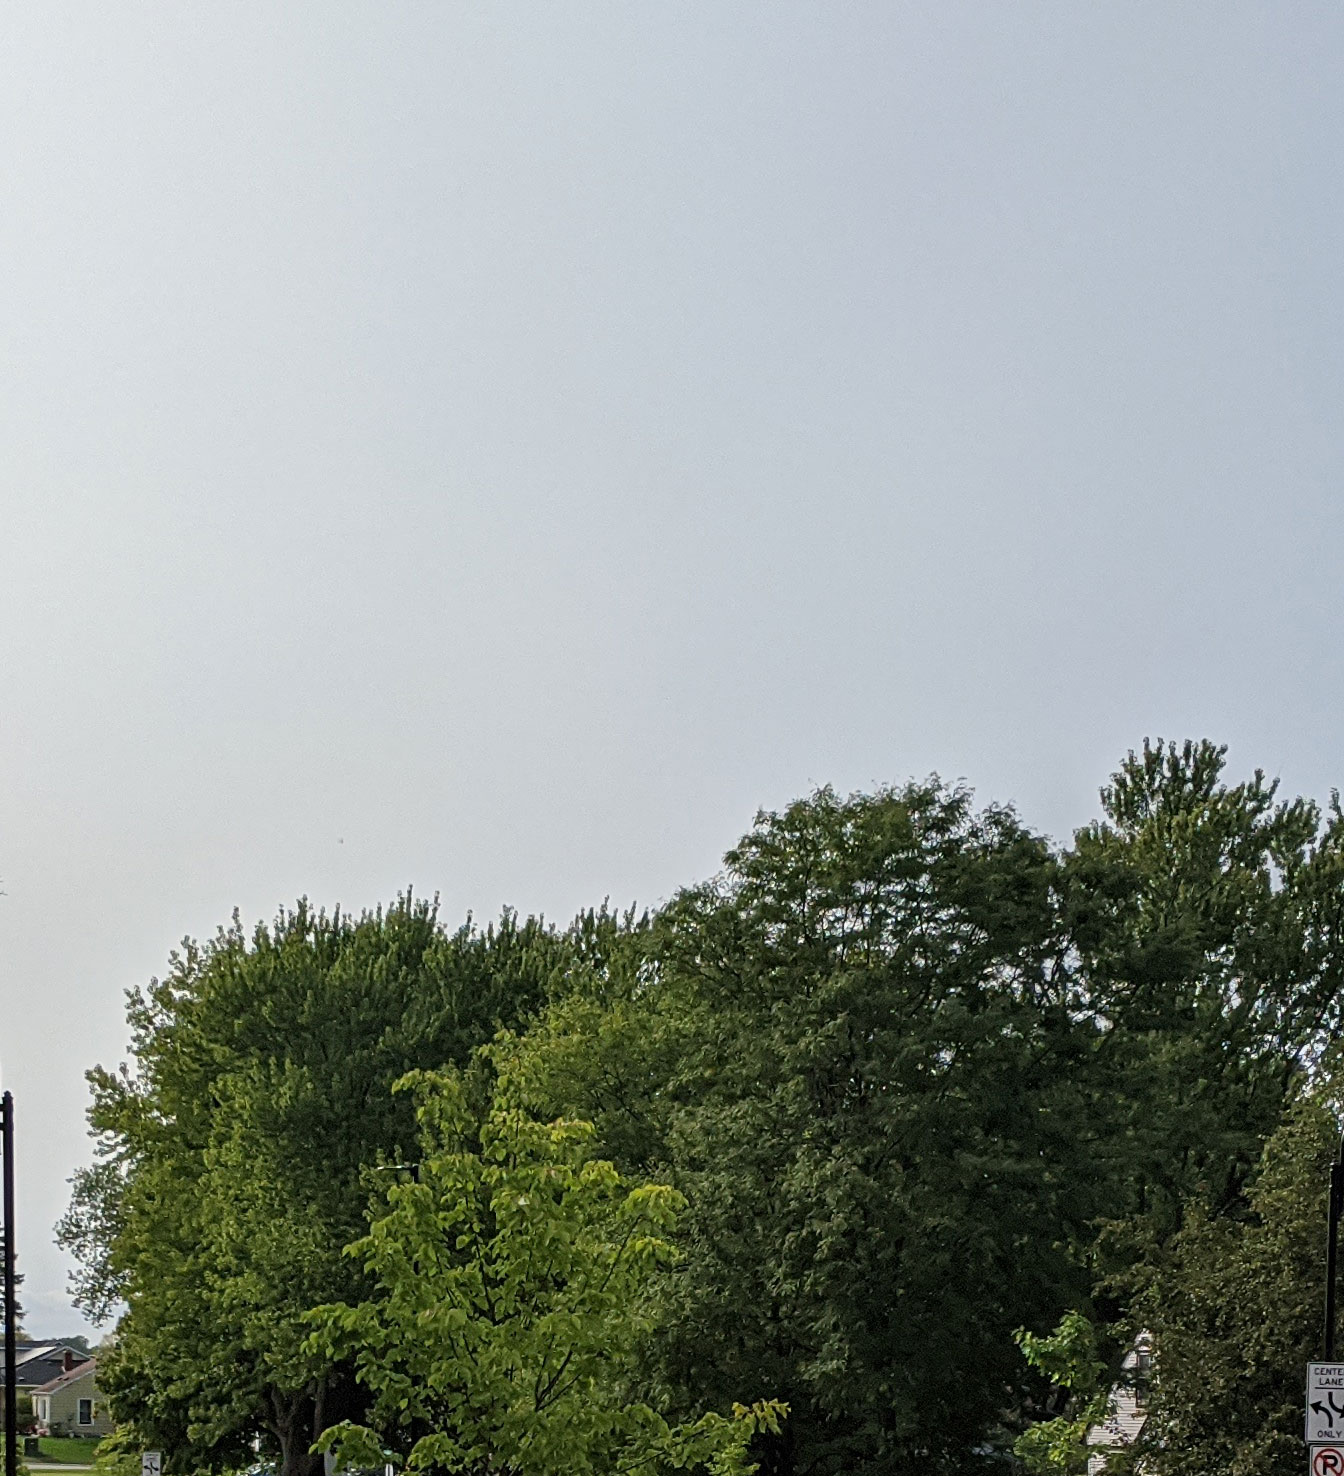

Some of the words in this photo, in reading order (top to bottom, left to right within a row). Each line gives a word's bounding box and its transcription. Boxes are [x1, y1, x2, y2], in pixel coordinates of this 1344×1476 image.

[1319, 1378, 1343, 1386] LANE
[1317, 1430, 1343, 1438] ONLY
[1323, 1455, 1338, 1475] P
